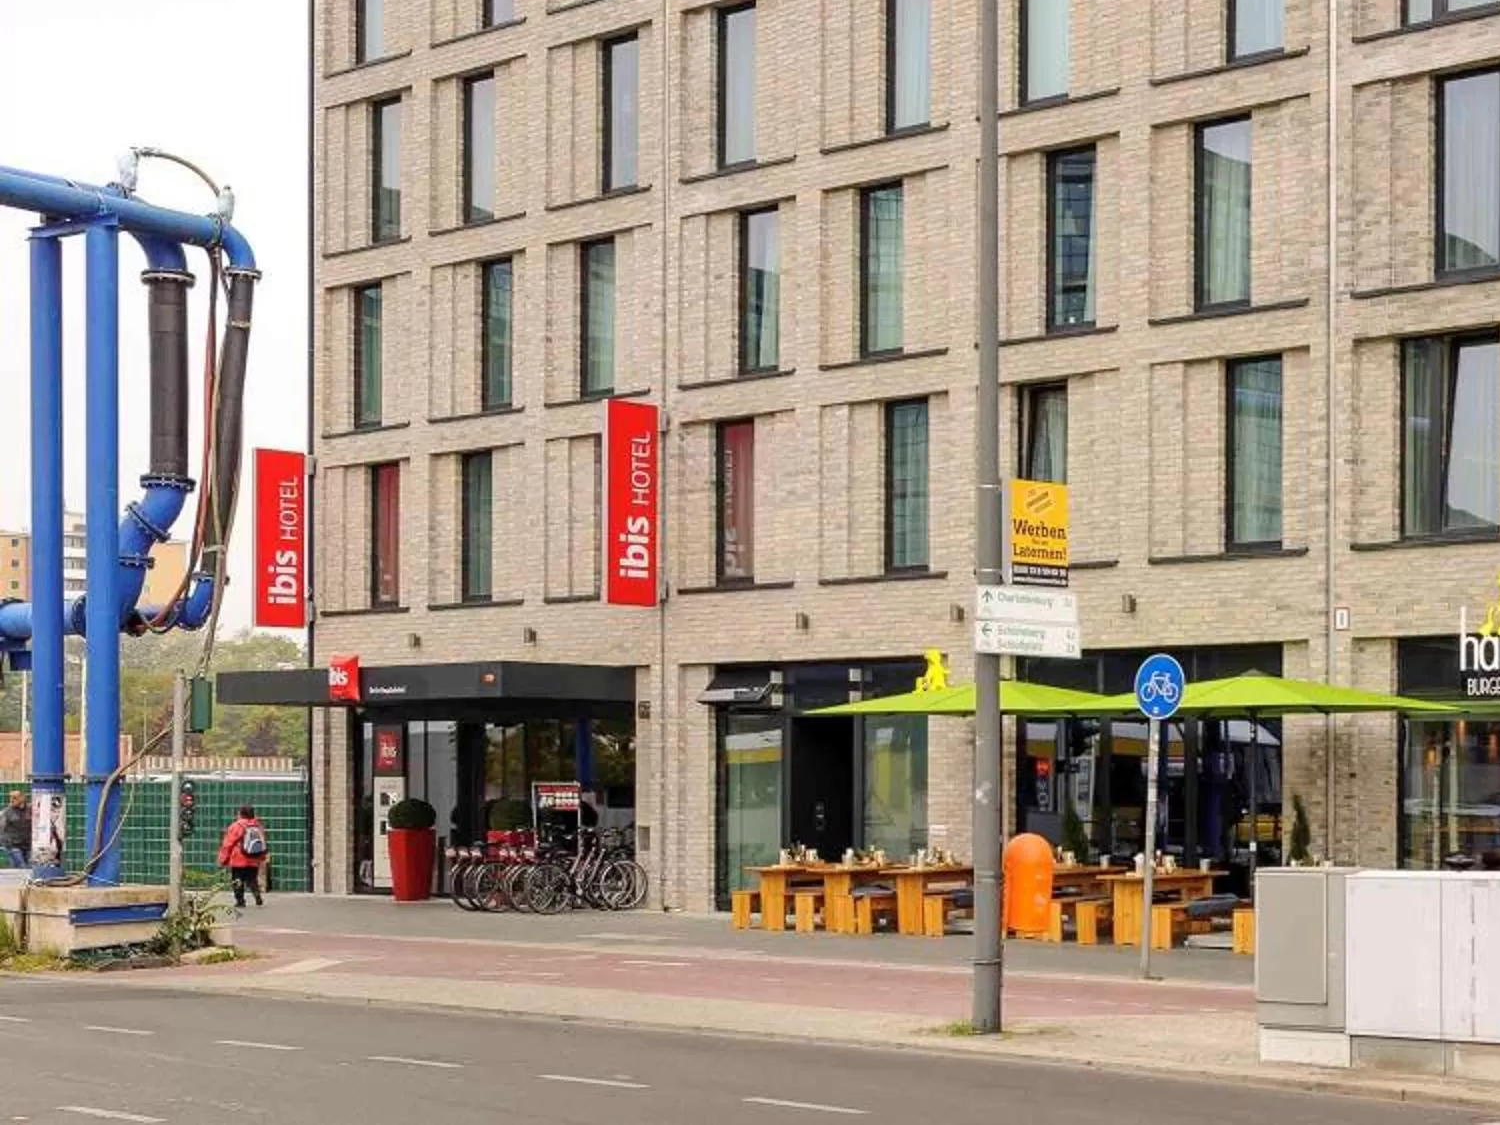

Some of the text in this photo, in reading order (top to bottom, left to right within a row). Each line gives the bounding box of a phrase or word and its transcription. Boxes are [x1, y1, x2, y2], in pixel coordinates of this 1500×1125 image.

[268, 476, 298, 604] ibis HOTEL
[619, 431, 651, 579] ibis HOTEL
[1012, 518, 1067, 539] Werben
